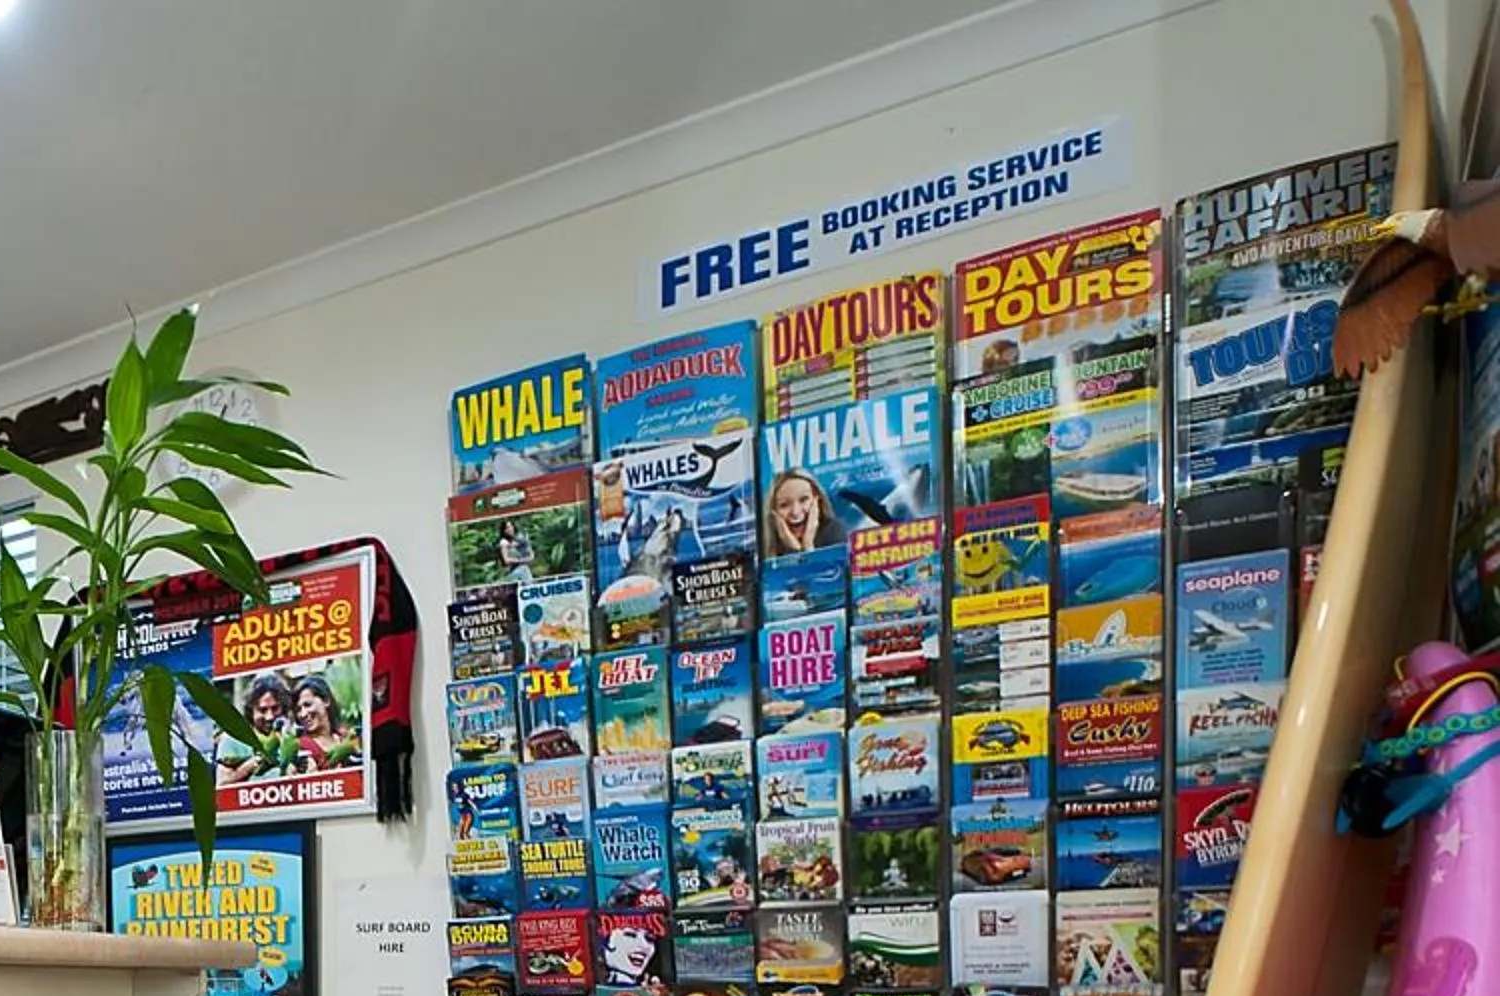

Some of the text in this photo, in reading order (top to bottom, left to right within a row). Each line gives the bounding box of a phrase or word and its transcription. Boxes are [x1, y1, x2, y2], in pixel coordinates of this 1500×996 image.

[823, 131, 1103, 235] BOOKING SERVICE
[1185, 149, 1398, 233] HUMMER
[849, 172, 1068, 254] AT RECEPTION
[660, 220, 810, 308] FREE
[963, 245, 1076, 301] DAY
[963, 258, 1155, 335] TOURS
[772, 305, 831, 367] DAY
[830, 271, 943, 346] TOURS
[603, 342, 745, 412] AQUADUCK
[457, 367, 585, 447] WHALE
[766, 406, 931, 471] WHALE
[626, 452, 700, 487] WHALES
[855, 520, 937, 549] JET SKI
[855, 542, 936, 568] SAFARIS
[519, 579, 583, 601] CRUISES
[1184, 566, 1282, 594] seaplane
[224, 602, 324, 644] ADULTS
[328, 599, 352, 625] @
[222, 626, 353, 667] KIDS PRICES
[769, 624, 836, 659] BOAT
[769, 655, 836, 691] HIRE
[1190, 710, 1231, 736] REEL
[238, 779, 345, 806] BOOK HERE
[526, 775, 580, 800] SURF
[599, 823, 657, 849] Whale
[603, 840, 663, 863] Watch
[165, 860, 244, 887] TWED
[136, 890, 213, 919] RIVER
[219, 884, 278, 914] AND
[356, 921, 431, 933] SURF BOARD
[378, 942, 405, 954] HIRE
